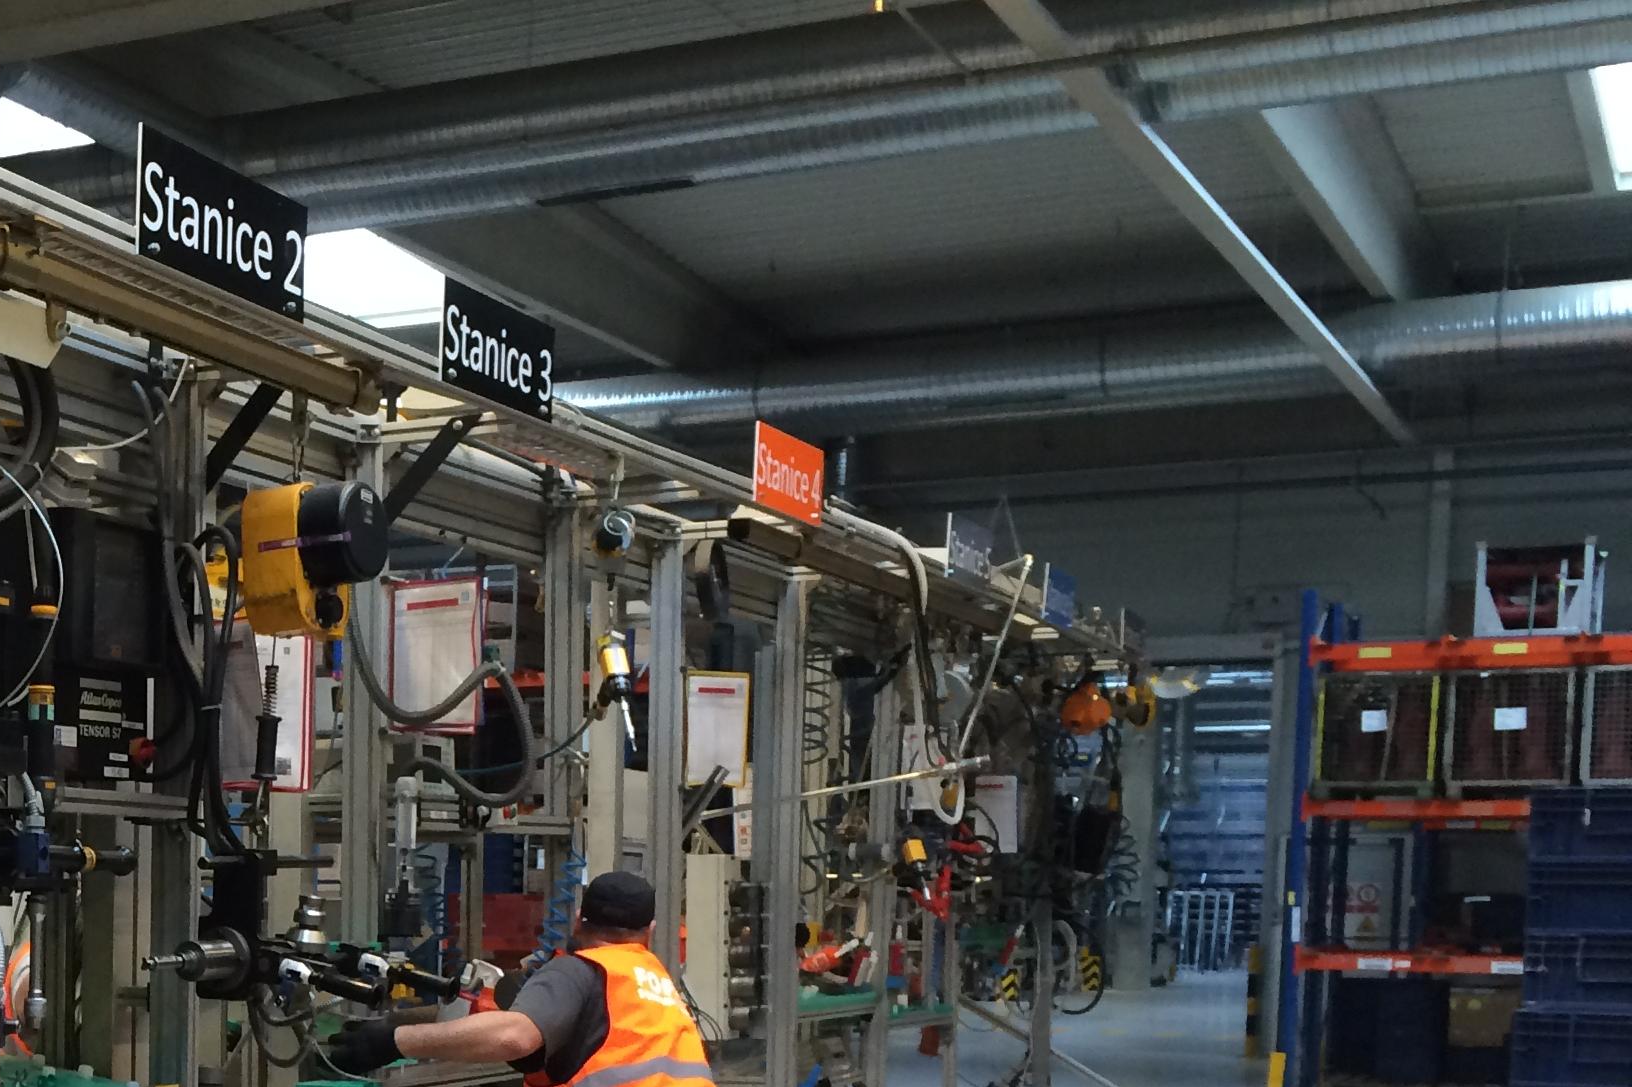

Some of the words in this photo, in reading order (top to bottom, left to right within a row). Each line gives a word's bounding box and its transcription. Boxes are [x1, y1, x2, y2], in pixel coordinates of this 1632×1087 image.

[142, 161, 273, 281] Stanice
[283, 229, 302, 297] 2
[445, 304, 533, 394] Stanice
[538, 349, 552, 402] 3
[757, 442, 809, 504] Stanice
[79, 723, 110, 738] TENSOR
